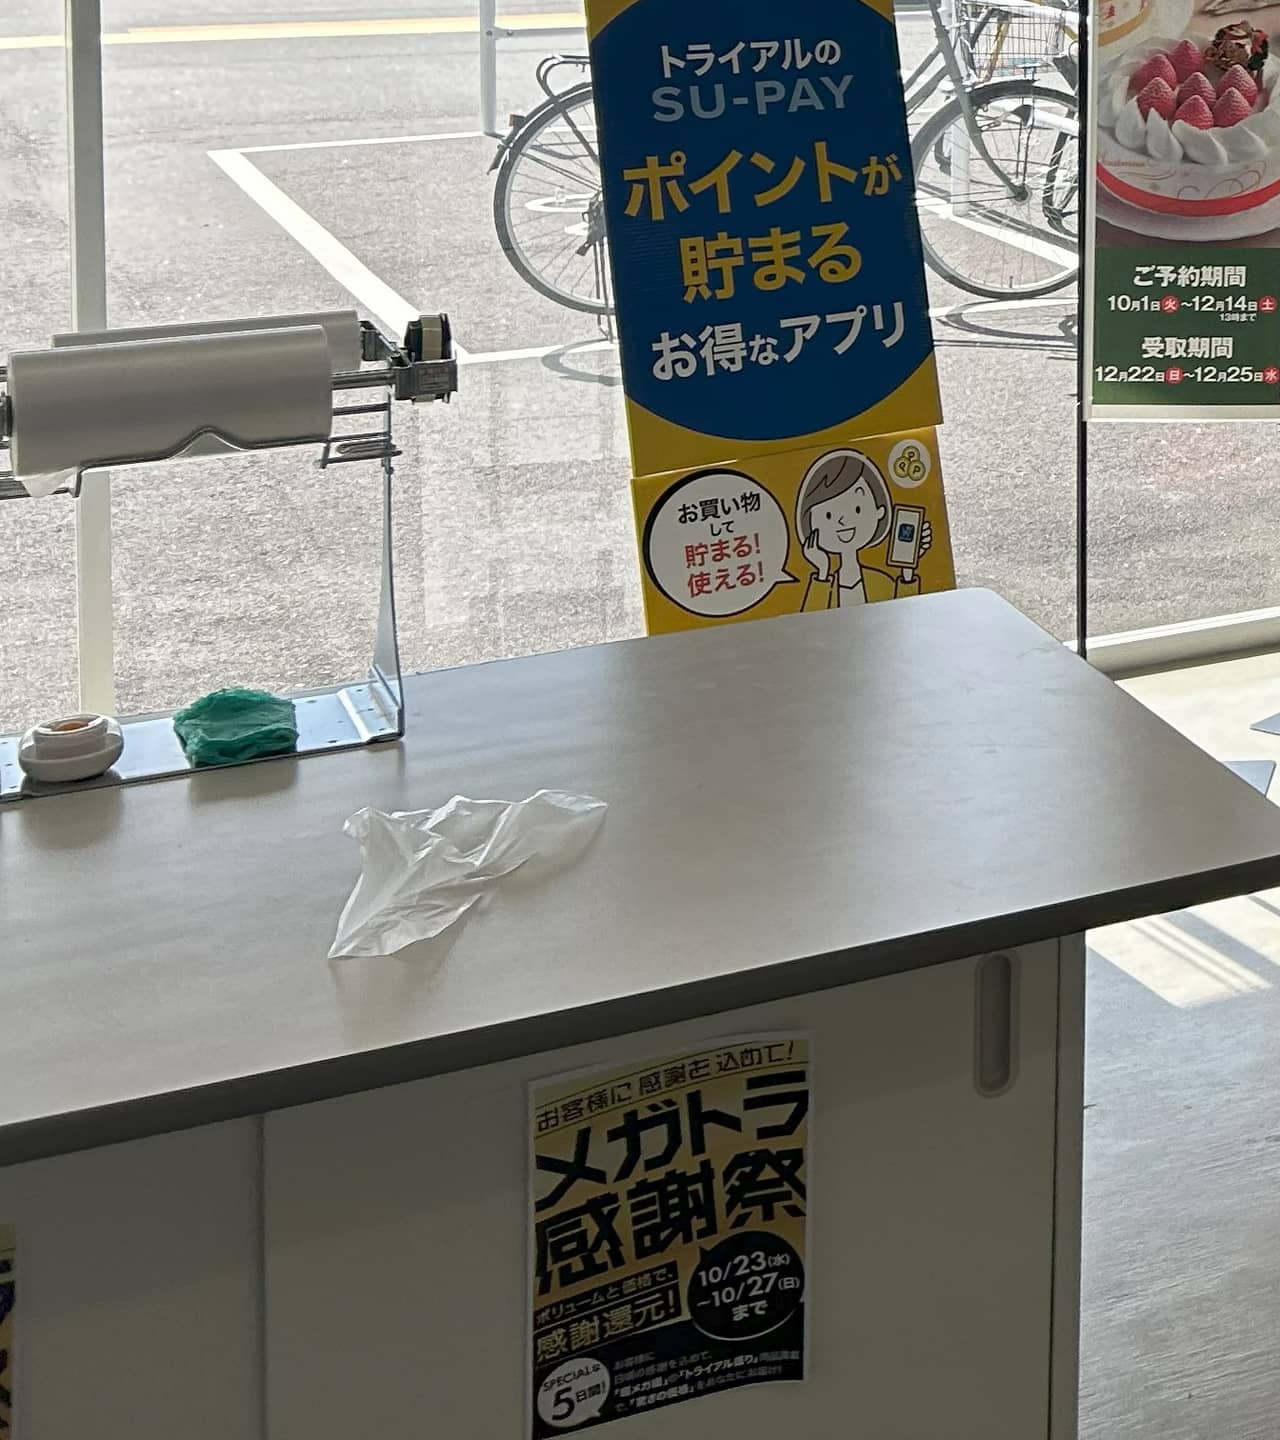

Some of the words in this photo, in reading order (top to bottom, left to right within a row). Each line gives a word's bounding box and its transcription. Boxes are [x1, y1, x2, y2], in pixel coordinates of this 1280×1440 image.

[659, 38, 842, 79] トライアルの
[651, 74, 854, 123] SU-PAY
[622, 140, 902, 221] ポイントが
[679, 222, 861, 304] 貯まる
[1132, 265, 1247, 289] ご予約期間
[1219, 313, 1257, 322] 13時まで
[649, 302, 906, 382] お得なアプリ
[1141, 337, 1233, 359] 受取期間
[677, 491, 761, 525] お買い物
[710, 520, 735, 536] して
[684, 532, 761, 568] 貯まる!
[686, 561, 765, 598] 使える!
[535, 1070, 808, 1212] メガトラ
[535, 1148, 806, 1296] 感謝祭
[732, 1303, 768, 1321] まで
